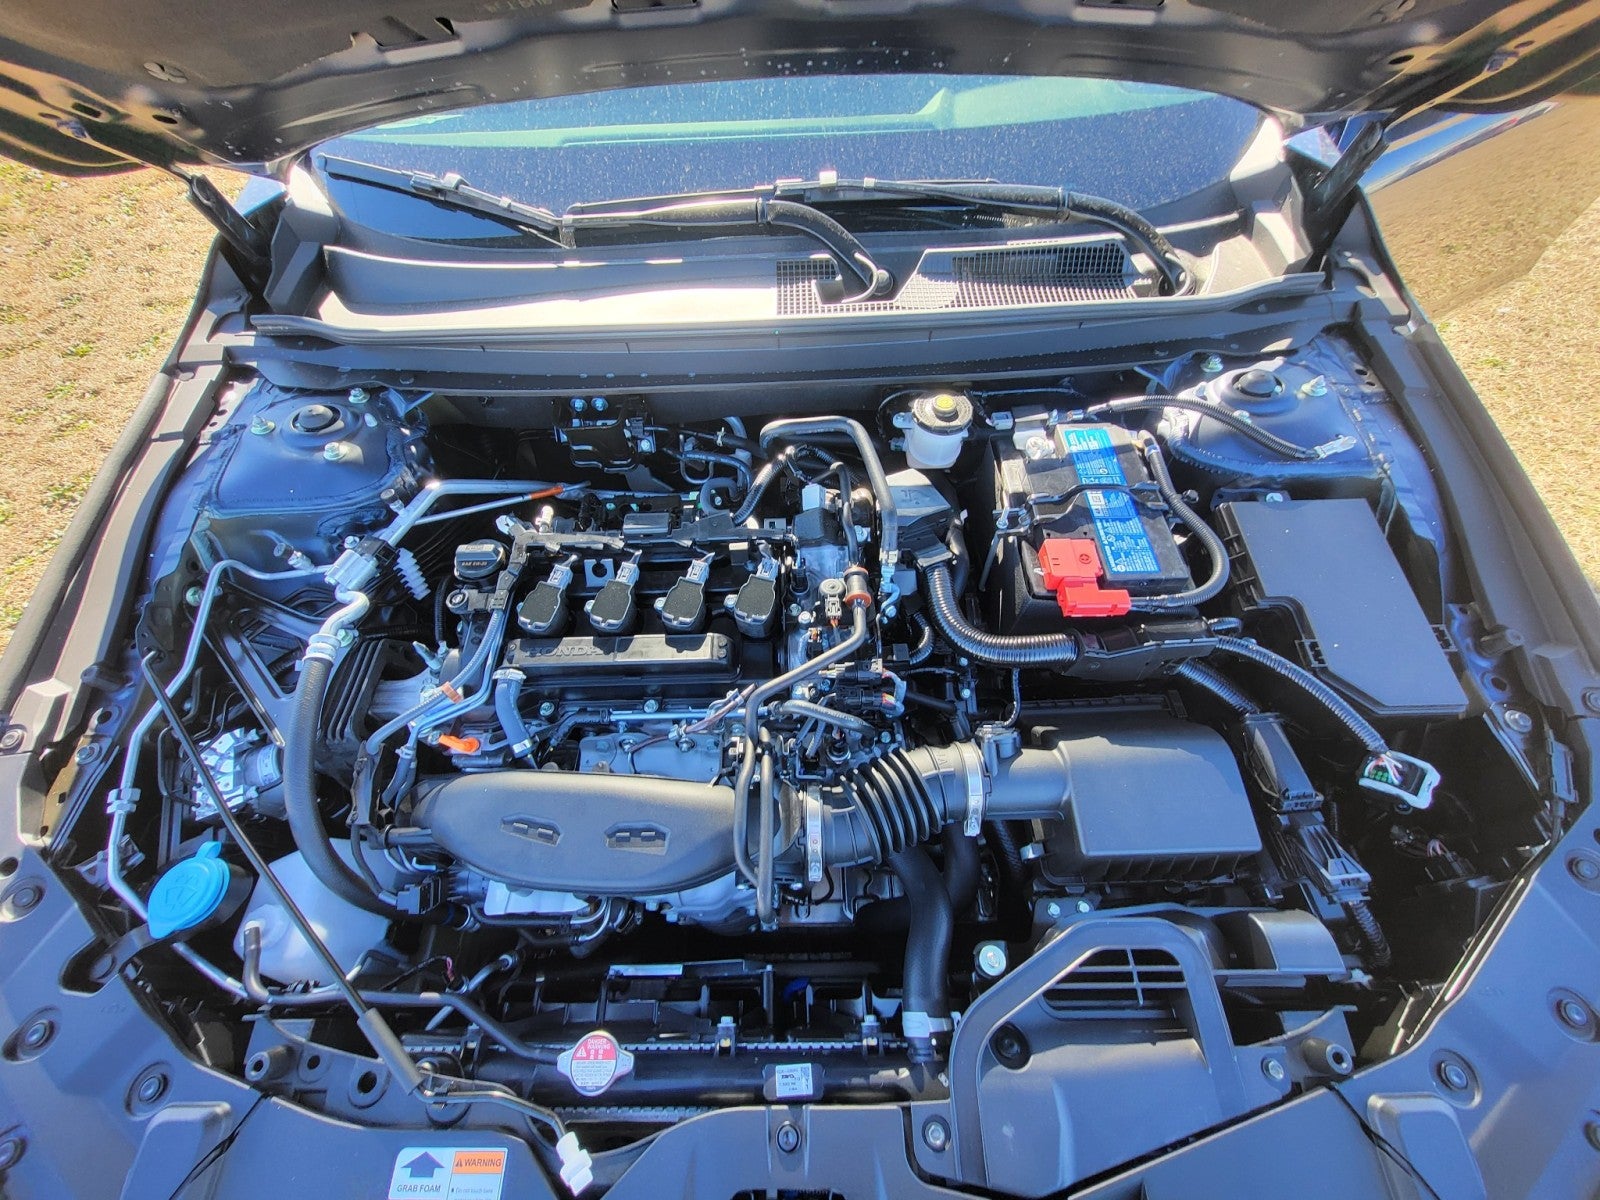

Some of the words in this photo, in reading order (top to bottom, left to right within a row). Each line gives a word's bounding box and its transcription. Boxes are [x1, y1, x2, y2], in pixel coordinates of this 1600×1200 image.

[525, 645, 603, 657] HONDA
[464, 1158, 502, 1167] WARNING
[397, 1185, 418, 1193] GRAB
[419, 1184, 441, 1192] FOAM
